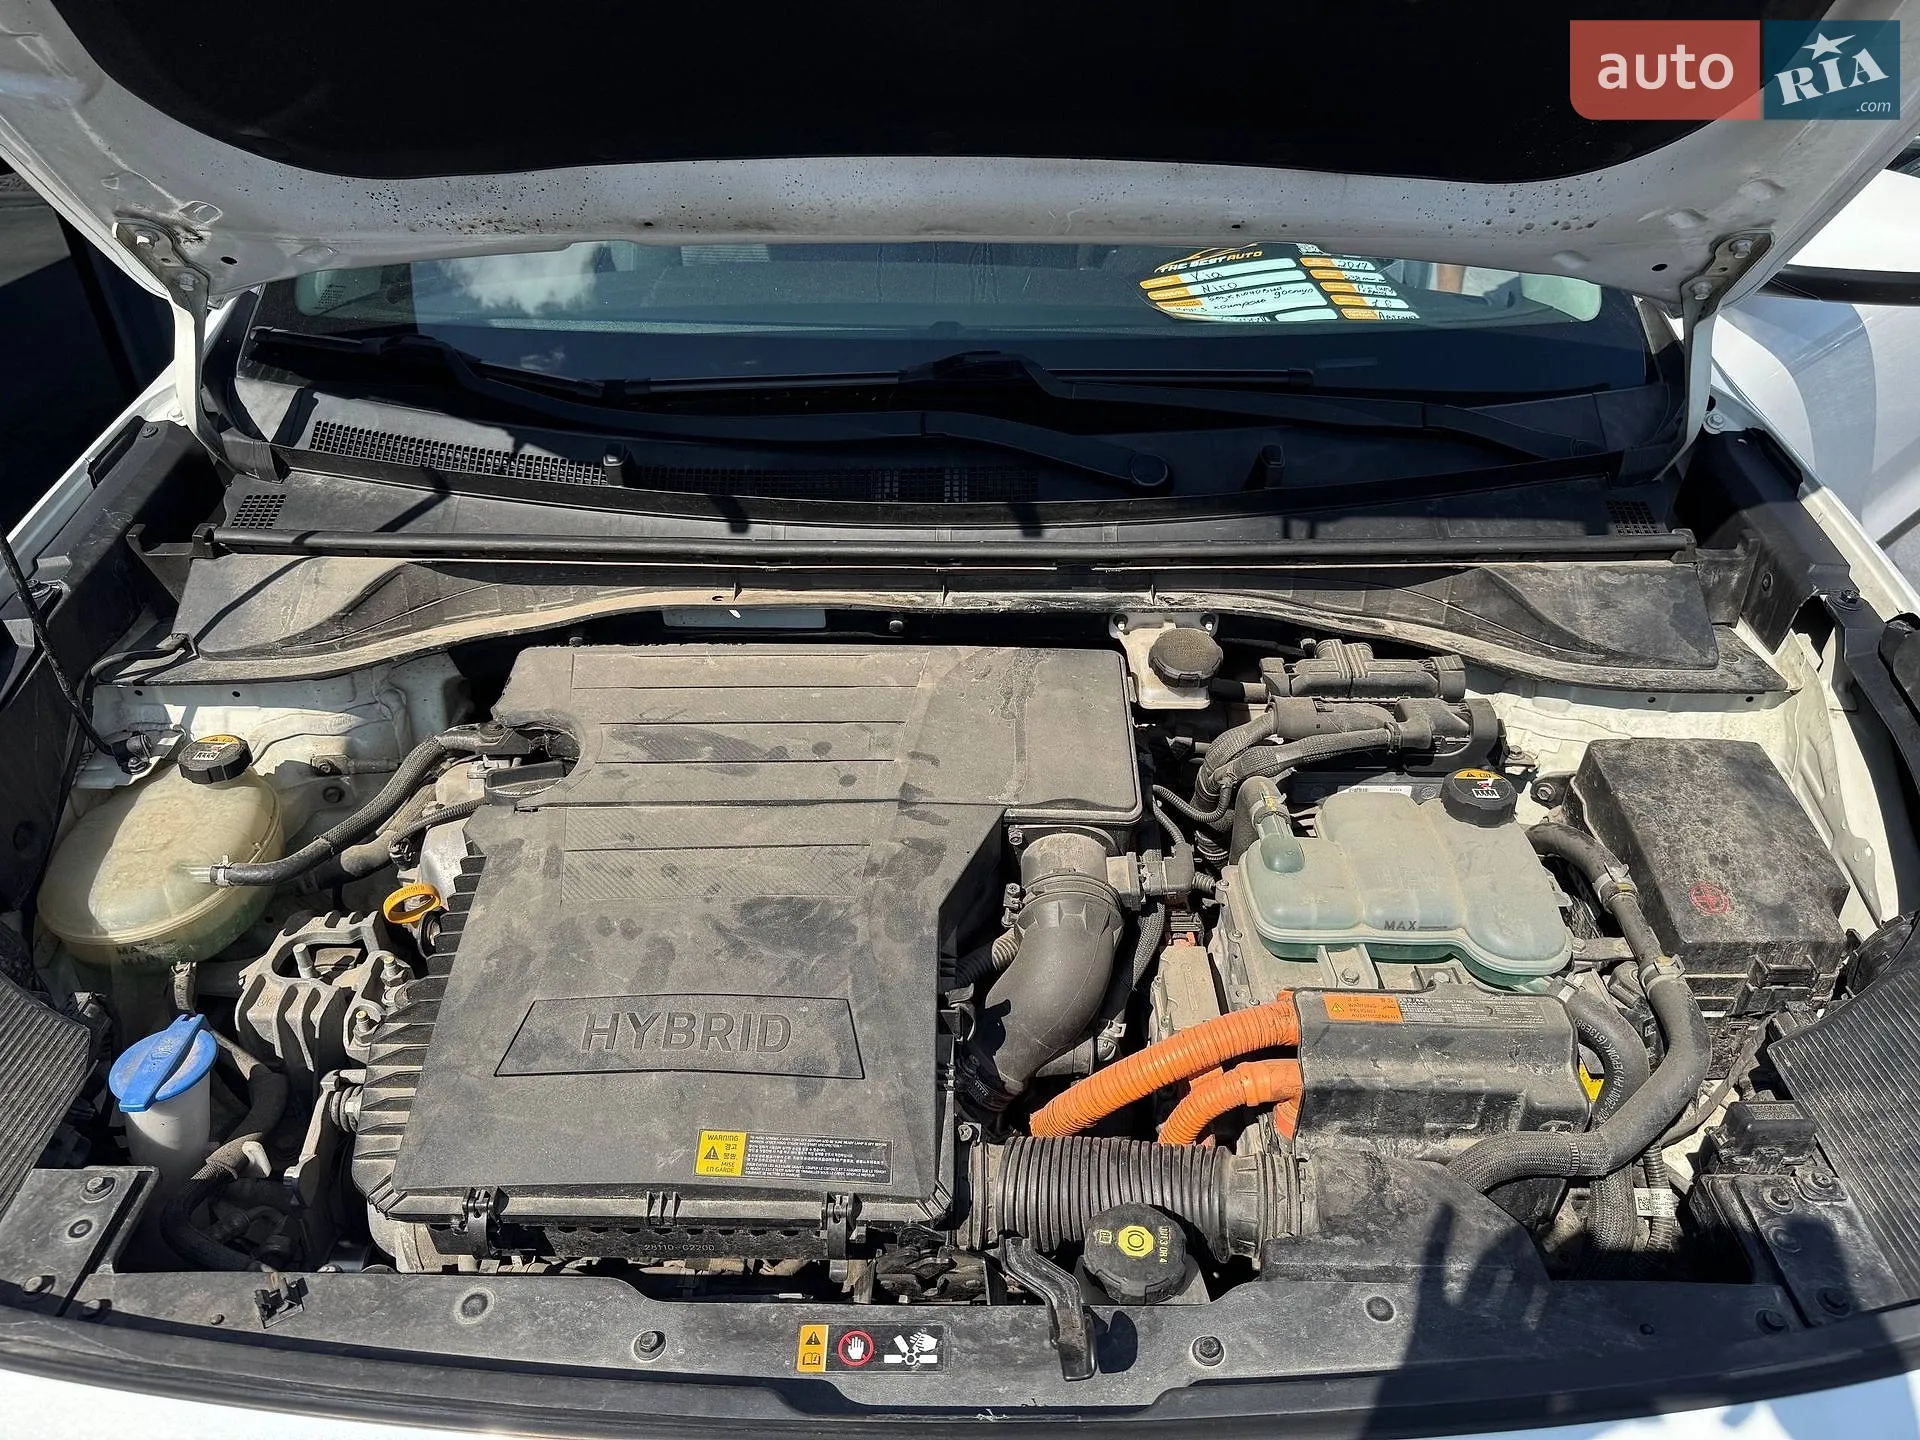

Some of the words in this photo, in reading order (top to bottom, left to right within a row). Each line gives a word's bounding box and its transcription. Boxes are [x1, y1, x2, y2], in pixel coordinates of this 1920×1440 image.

[1383, 919, 1417, 930] MAX
[580, 1011, 792, 1053] HYBRID
[707, 1134, 739, 1142] WARNING
